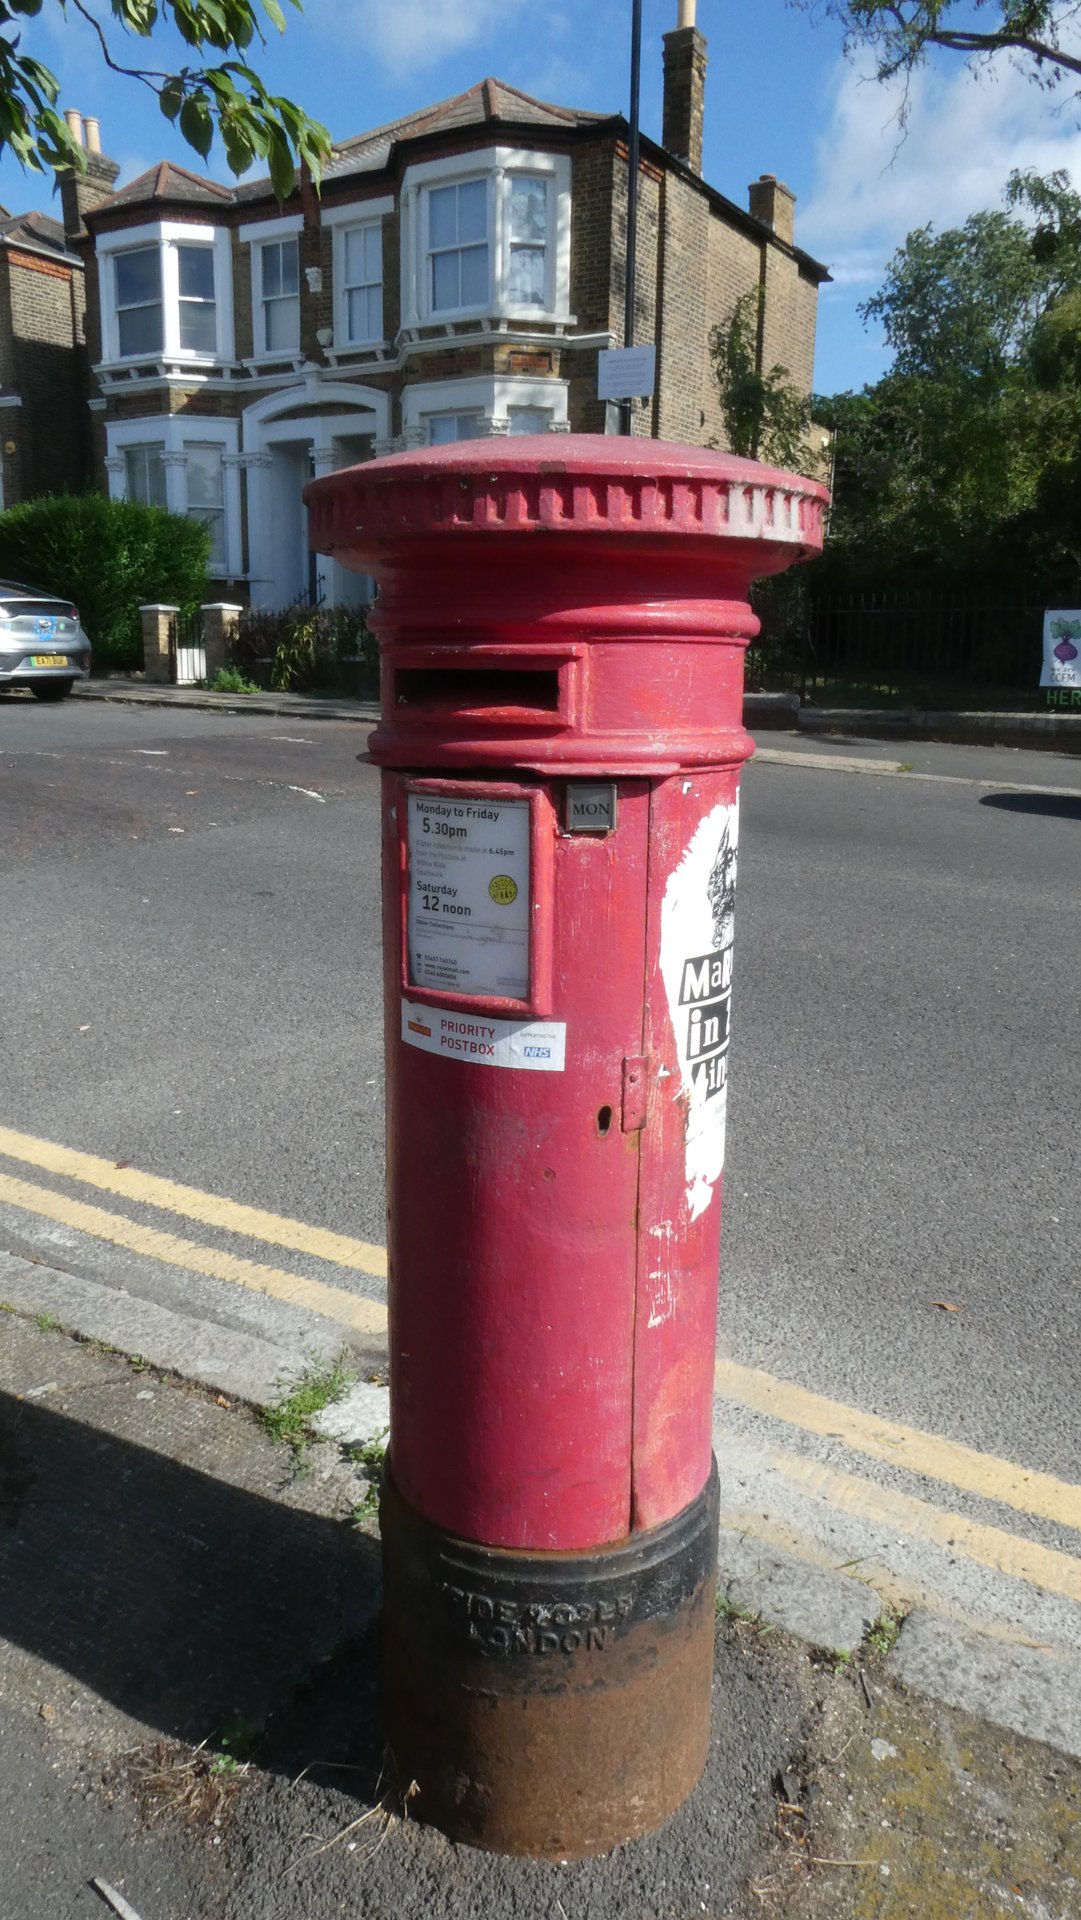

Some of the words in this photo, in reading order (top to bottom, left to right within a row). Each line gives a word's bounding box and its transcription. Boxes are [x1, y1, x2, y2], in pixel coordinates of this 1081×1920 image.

[416, 802, 452, 818] Monday
[454, 807, 464, 817] to
[466, 808, 500, 822] Friday
[573, 803, 610, 816] MON
[422, 817, 467, 838] 5.30pm
[488, 848, 515, 857] 6.45pm
[416, 880, 458, 898] Saturday
[422, 894, 439, 912] 12
[442, 903, 471, 916] noon
[440, 1019, 495, 1039] PRIORITY
[690, 1008, 719, 1057] in
[440, 1036, 495, 1056] POSTBOX
[524, 1047, 550, 1058] NHS
